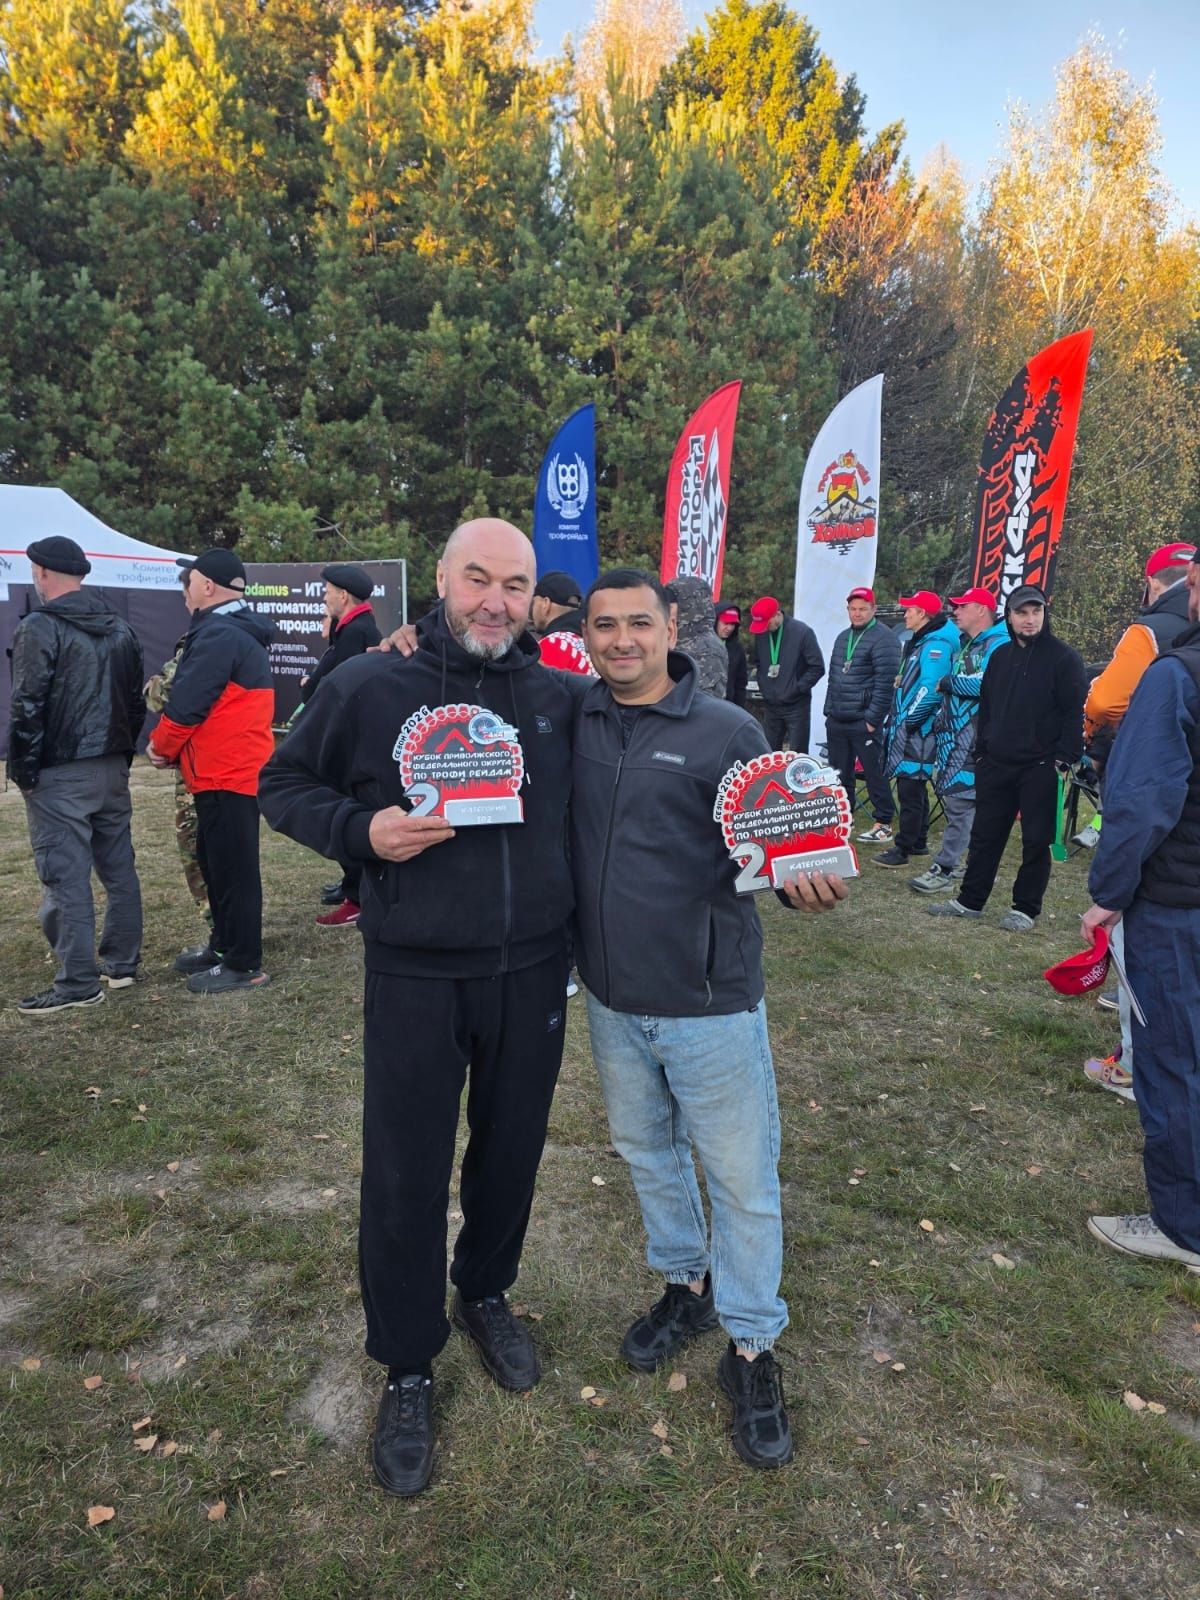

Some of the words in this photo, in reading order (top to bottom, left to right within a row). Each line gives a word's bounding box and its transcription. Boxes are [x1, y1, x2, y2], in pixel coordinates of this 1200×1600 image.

[677, 437, 703, 578] РИТОРИЯ
[132, 562, 176, 574] Комитет
[117, 573, 180, 585] трофи-рейд
[245, 582, 289, 597] odamus
[256, 602, 326, 615] автоматиза
[413, 753, 442, 761] КУБОК
[443, 750, 511, 760] ПРИВОЛЖСКОГО
[412, 760, 479, 770] ФЕДЕРАЛЬНОГО
[481, 759, 512, 767] ОКРУГА
[413, 772, 428, 780] ПО
[431, 770, 466, 779] ТРОФИ
[733, 809, 762, 821] КУБОК
[763, 796, 834, 815] ПРИВОЛЖСКОГО
[733, 812, 801, 830] ФЕДЕРАЛЬНОГО
[803, 805, 837, 818] ОКРУГА
[736, 831, 750, 841] ПО
[753, 824, 789, 838] ТРОФИ
[728, 842, 773, 896] 2
